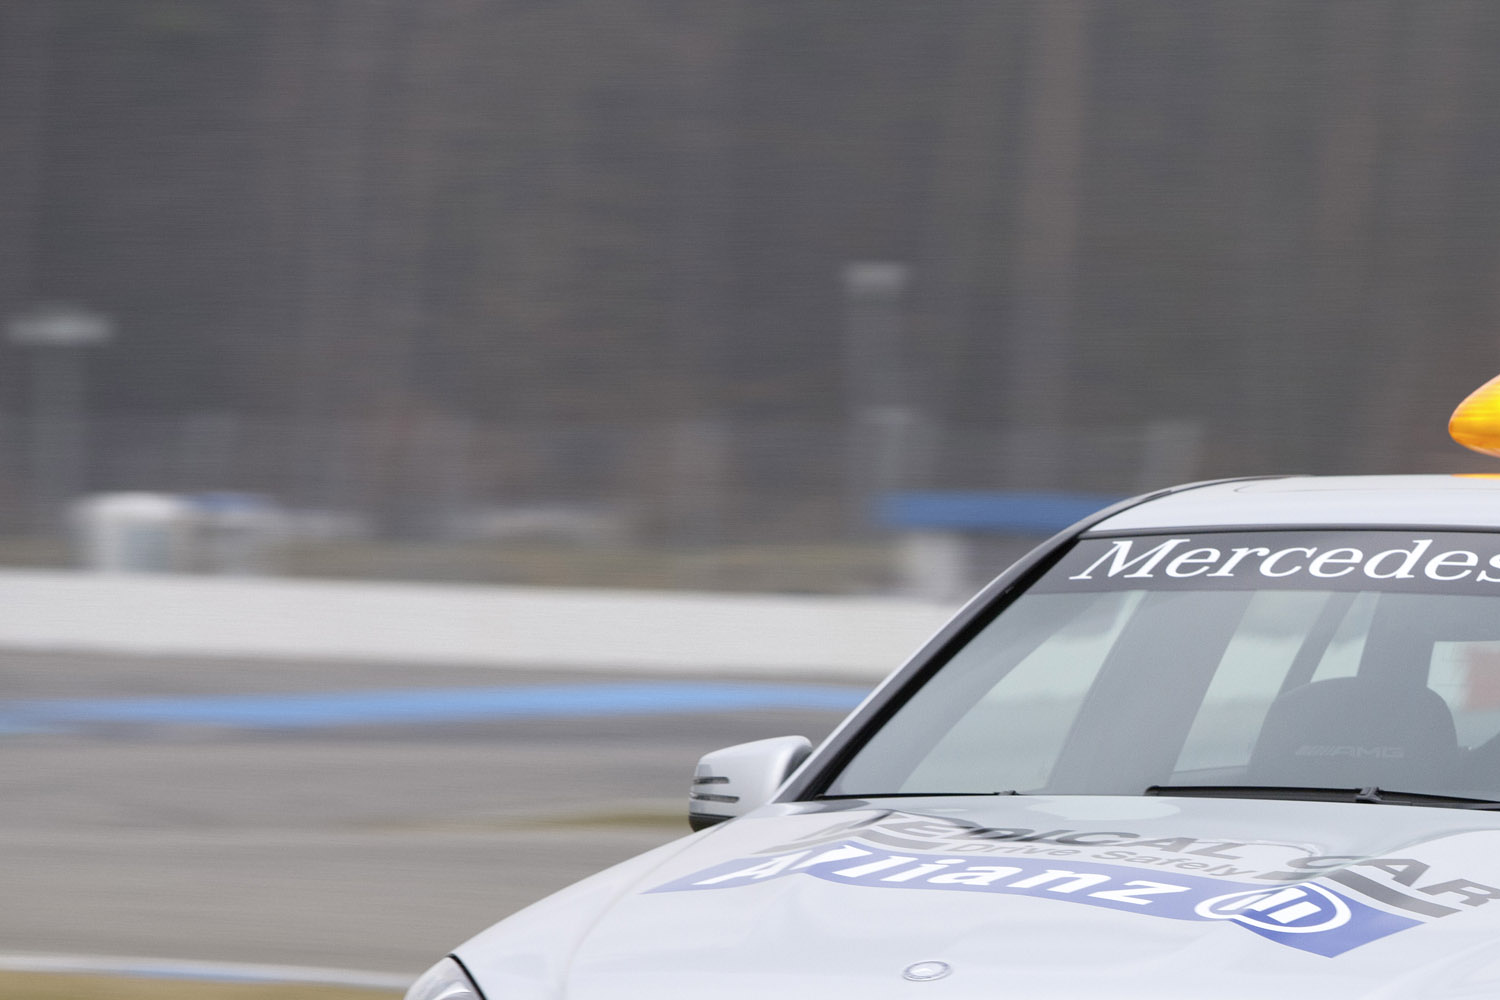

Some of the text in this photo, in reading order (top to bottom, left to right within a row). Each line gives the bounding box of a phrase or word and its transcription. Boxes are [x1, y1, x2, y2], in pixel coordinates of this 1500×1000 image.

[691, 844, 1192, 906] Allianz
[948, 842, 1256, 877] Drive Safely
